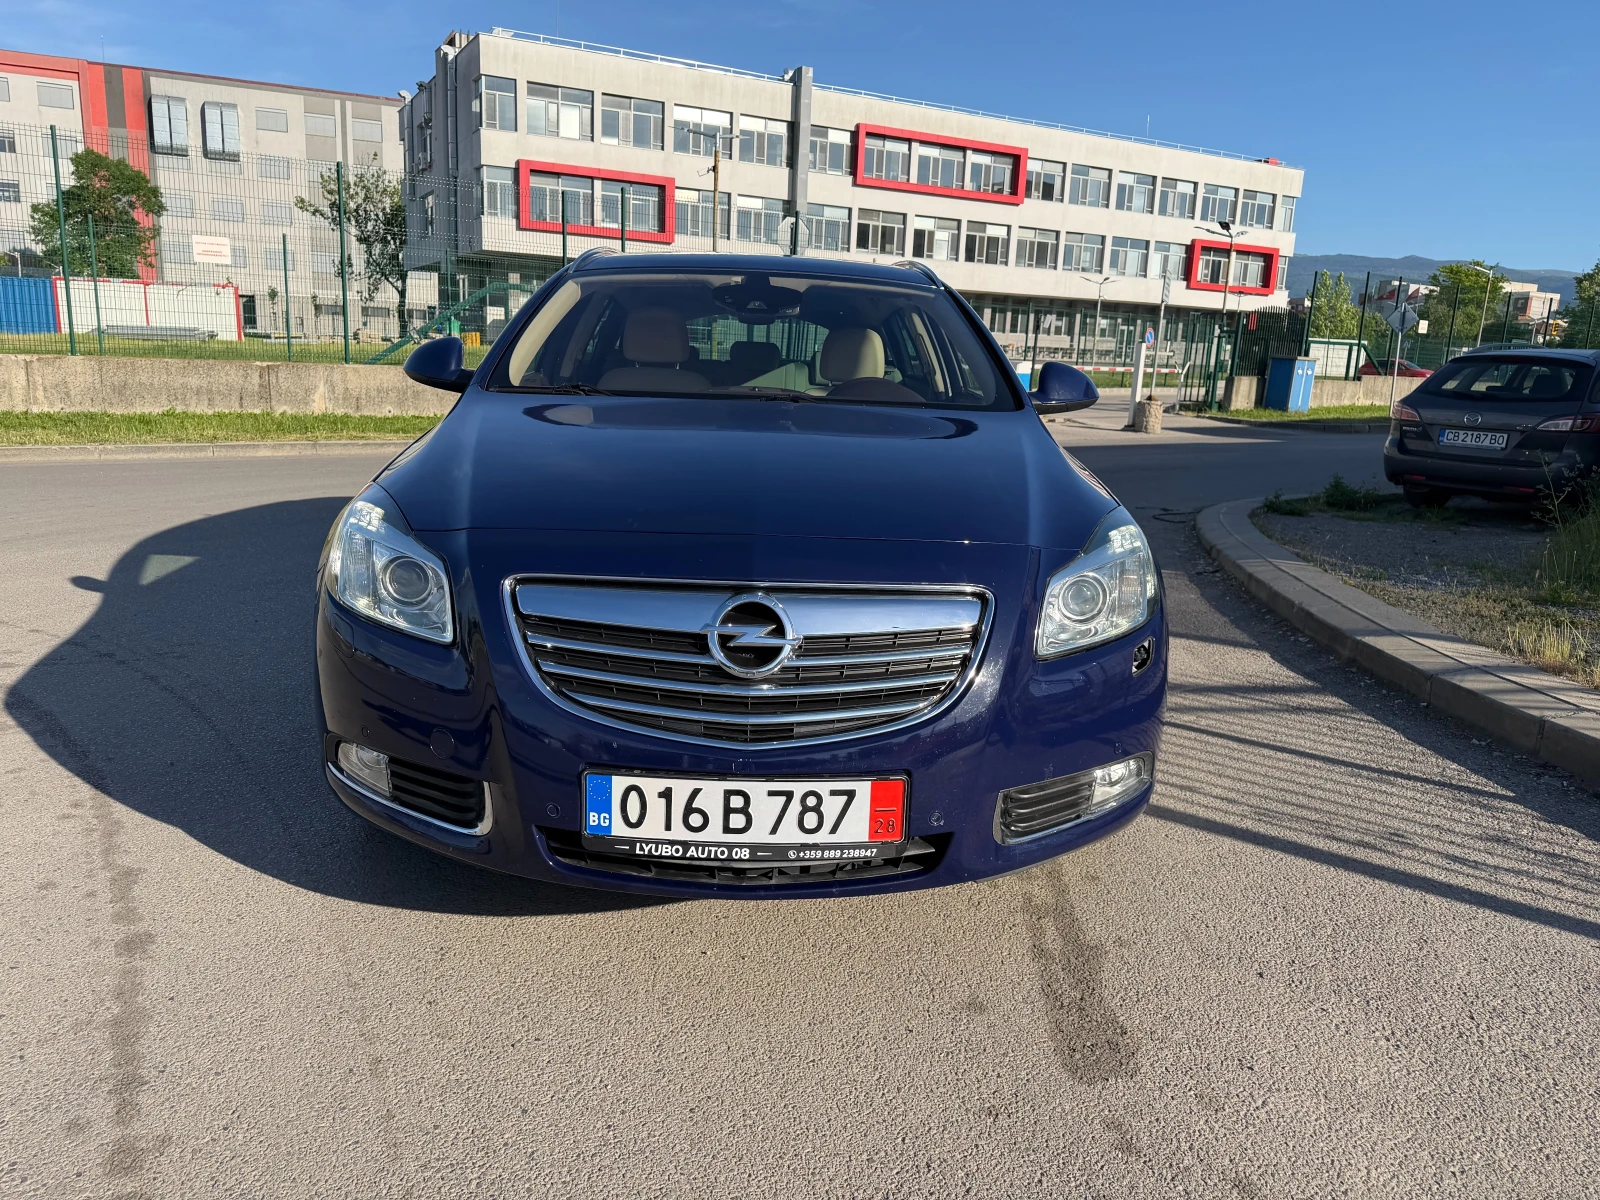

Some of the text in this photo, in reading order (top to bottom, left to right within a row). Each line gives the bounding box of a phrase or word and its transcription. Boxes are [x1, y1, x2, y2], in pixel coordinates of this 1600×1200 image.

[1446, 431, 1460, 442] CB
[1461, 432, 1489, 444] 2187
[620, 784, 857, 836] 016 B 787
[589, 811, 610, 827] BG
[874, 817, 897, 834] 28
[635, 842, 750, 859] LYUBO AUTO 08
[798, 848, 877, 858] +359 889 238947
